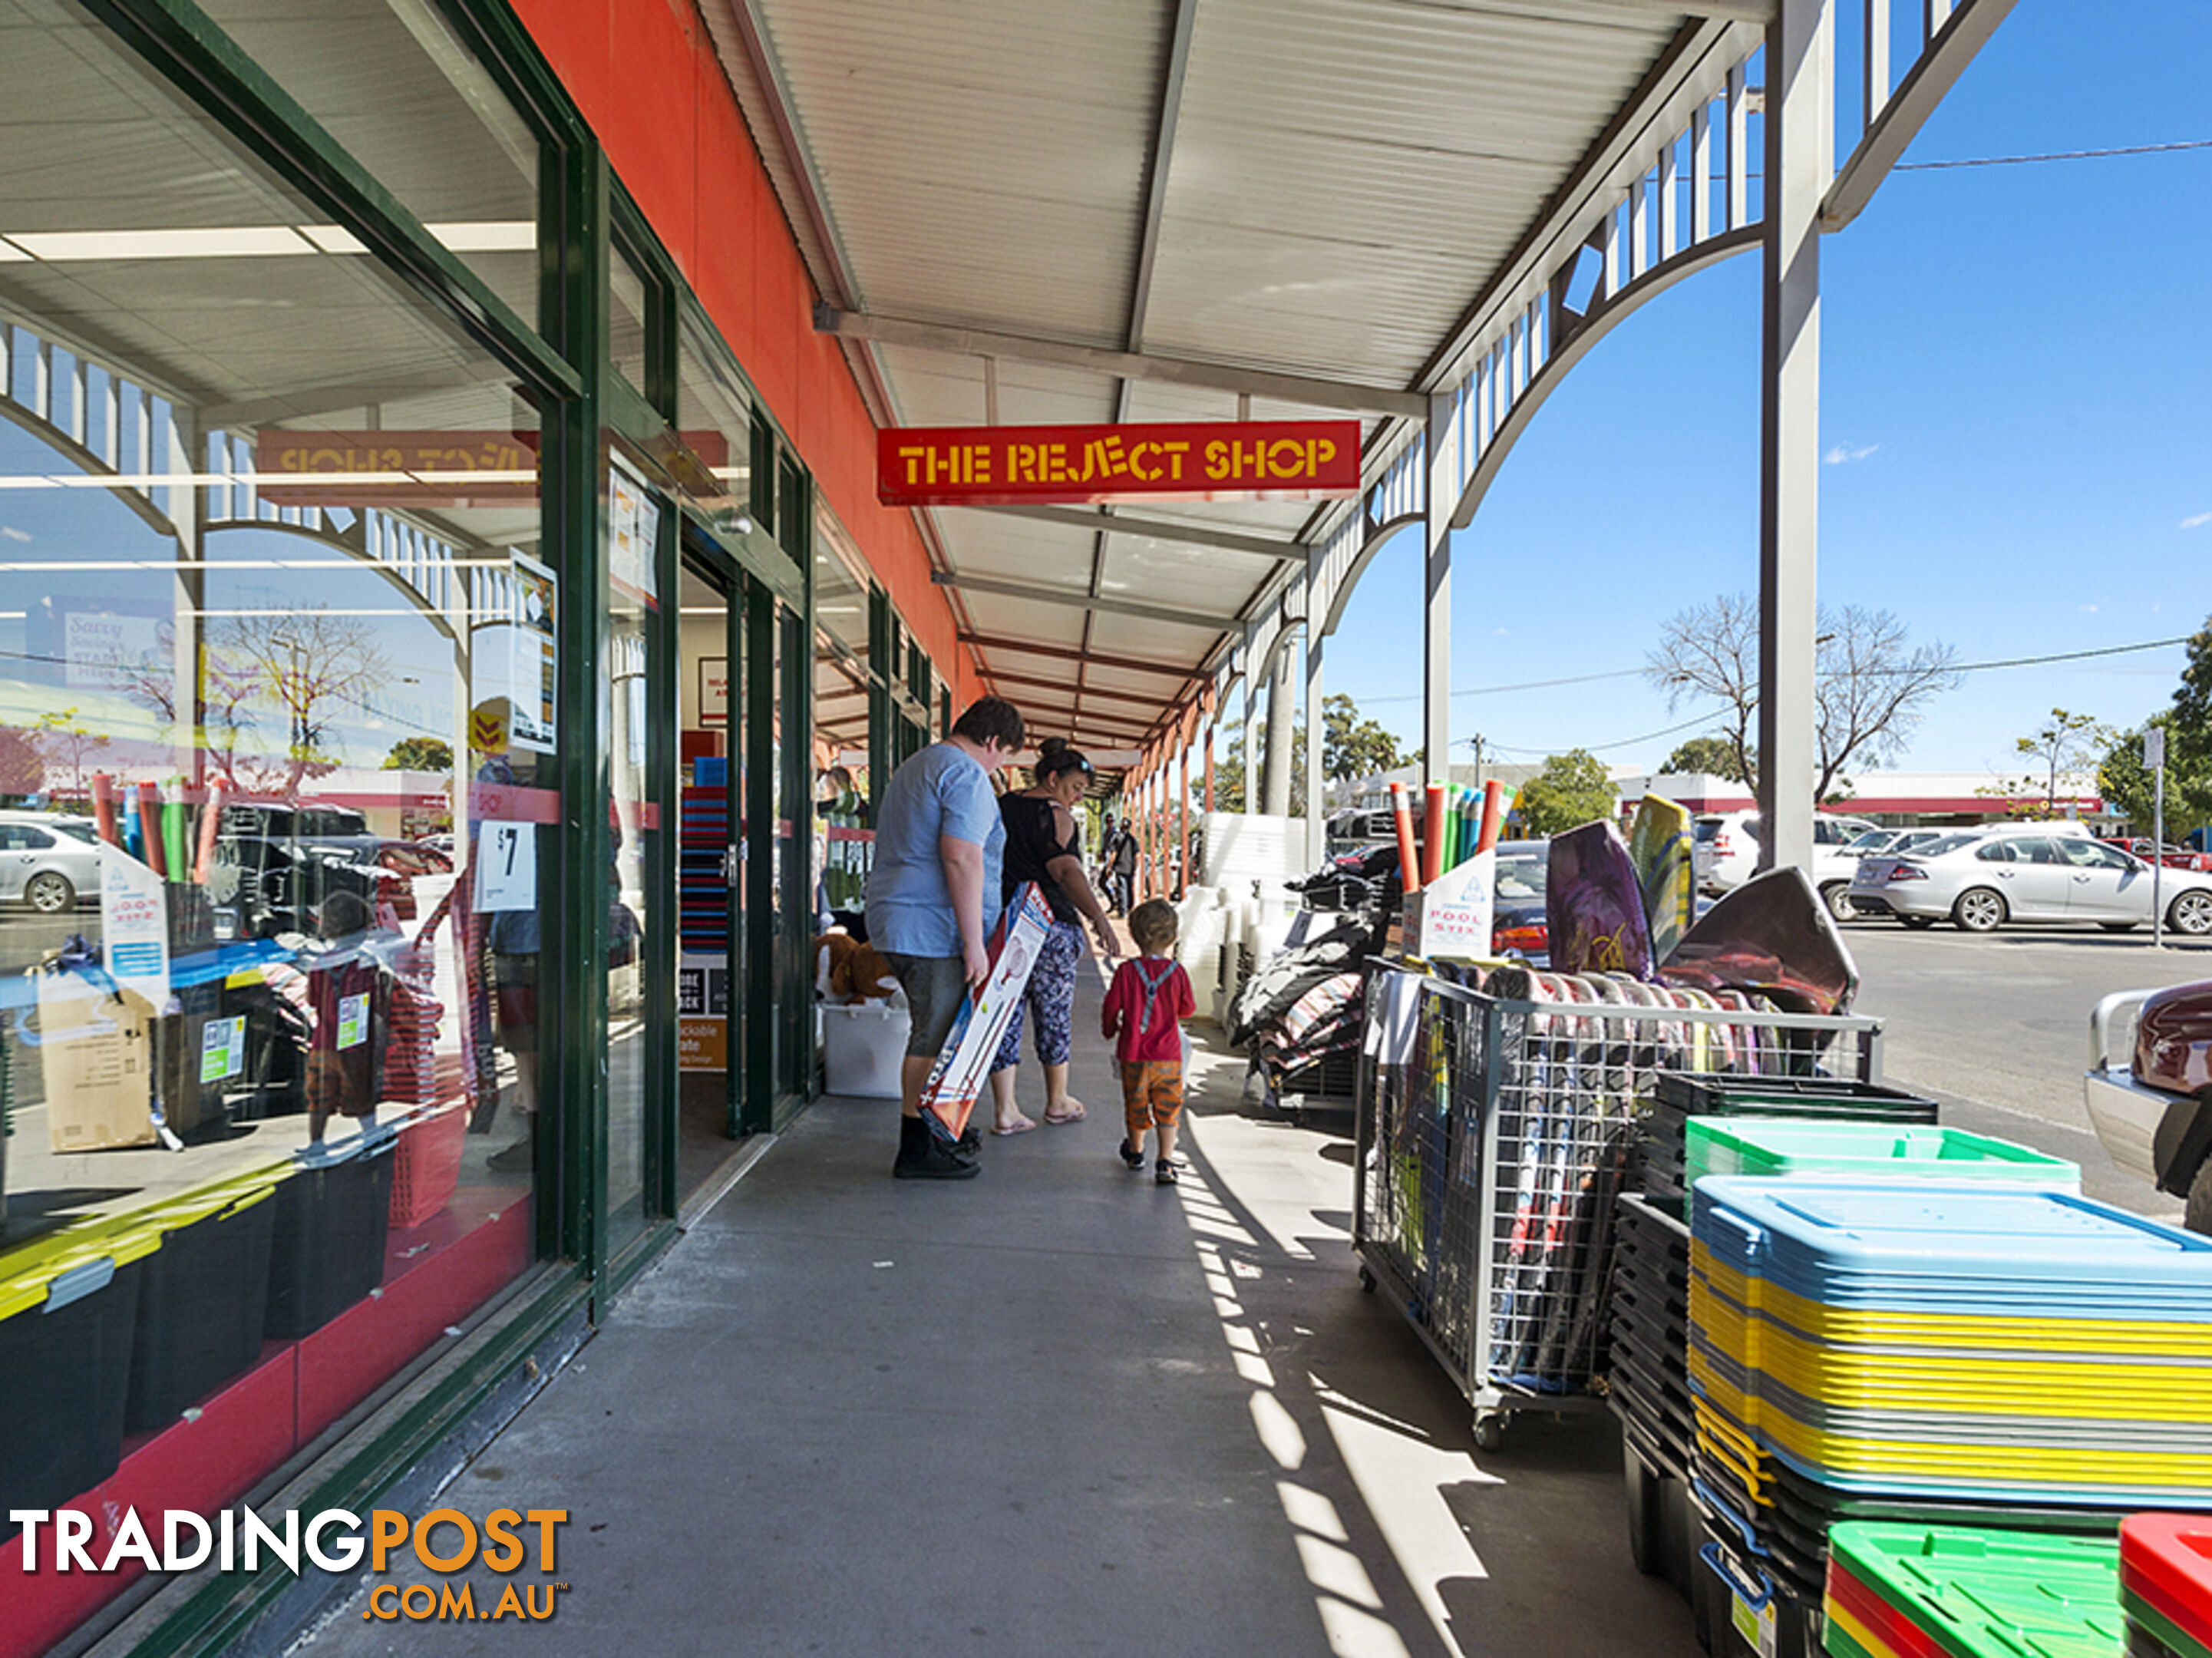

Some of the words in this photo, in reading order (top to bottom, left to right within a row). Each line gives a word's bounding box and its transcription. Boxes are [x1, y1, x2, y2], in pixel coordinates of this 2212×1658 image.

[899, 446, 991, 484] THE
[1007, 434, 1190, 482] REJECT
[1205, 438, 1336, 479] SHOP
[497, 828, 517, 876] $7
[1431, 910, 1481, 924] POOL
